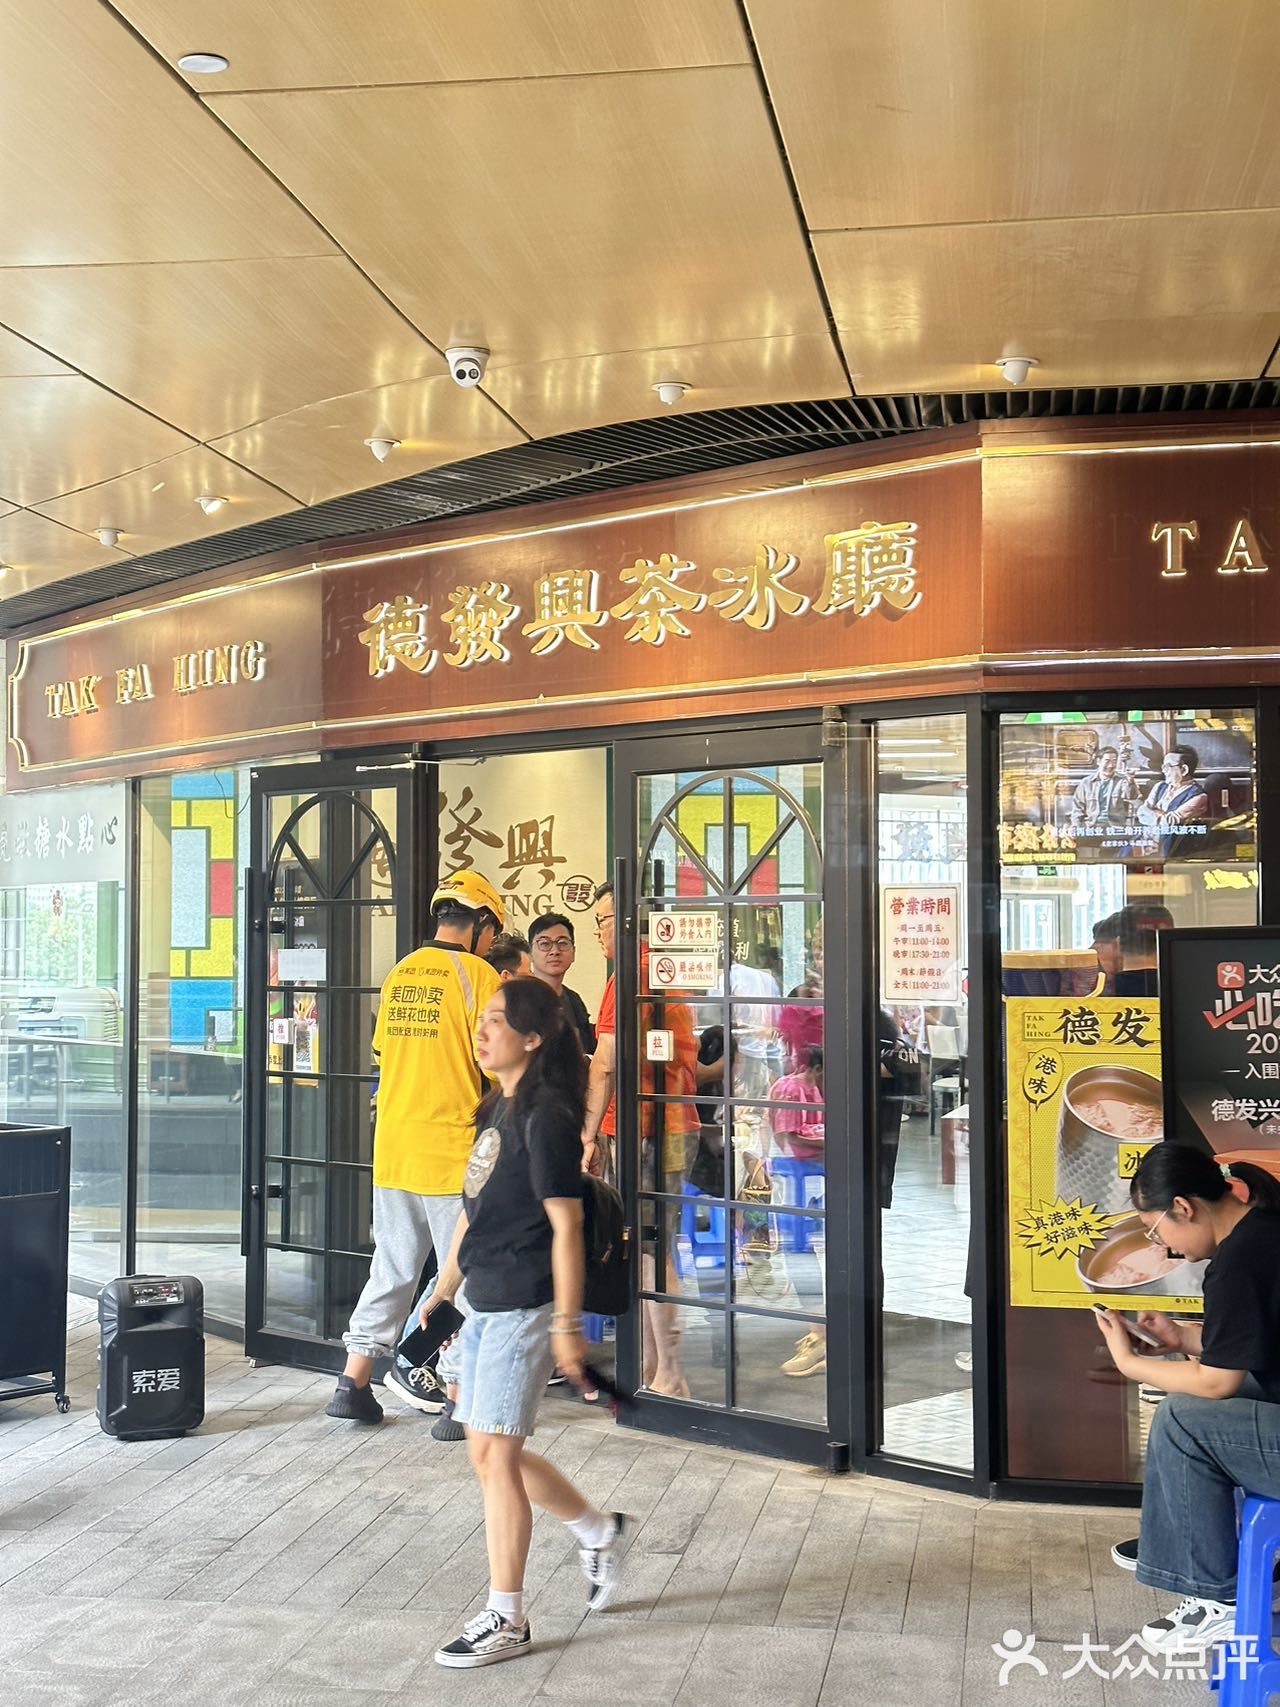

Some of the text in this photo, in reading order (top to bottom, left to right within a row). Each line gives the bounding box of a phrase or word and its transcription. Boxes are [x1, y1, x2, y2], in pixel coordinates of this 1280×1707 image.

[358, 521, 923, 678] 德發興茶冰廳
[45, 640, 266, 718] TAK FA HING
[890, 897, 951, 915] 營業時間
[390, 985, 444, 1005] 美团外卖
[388, 1007, 440, 1023] 送鲜花也快
[1054, 1006, 1160, 1048] 德发
[653, 1036, 663, 1048] 拉
[1246, 1033, 1280, 1054] 20
[1028, 1054, 1057, 1094] 港味
[1033, 1207, 1082, 1232] 真港味
[1044, 1221, 1093, 1244] 好滋味
[132, 1367, 180, 1394] 索爱
